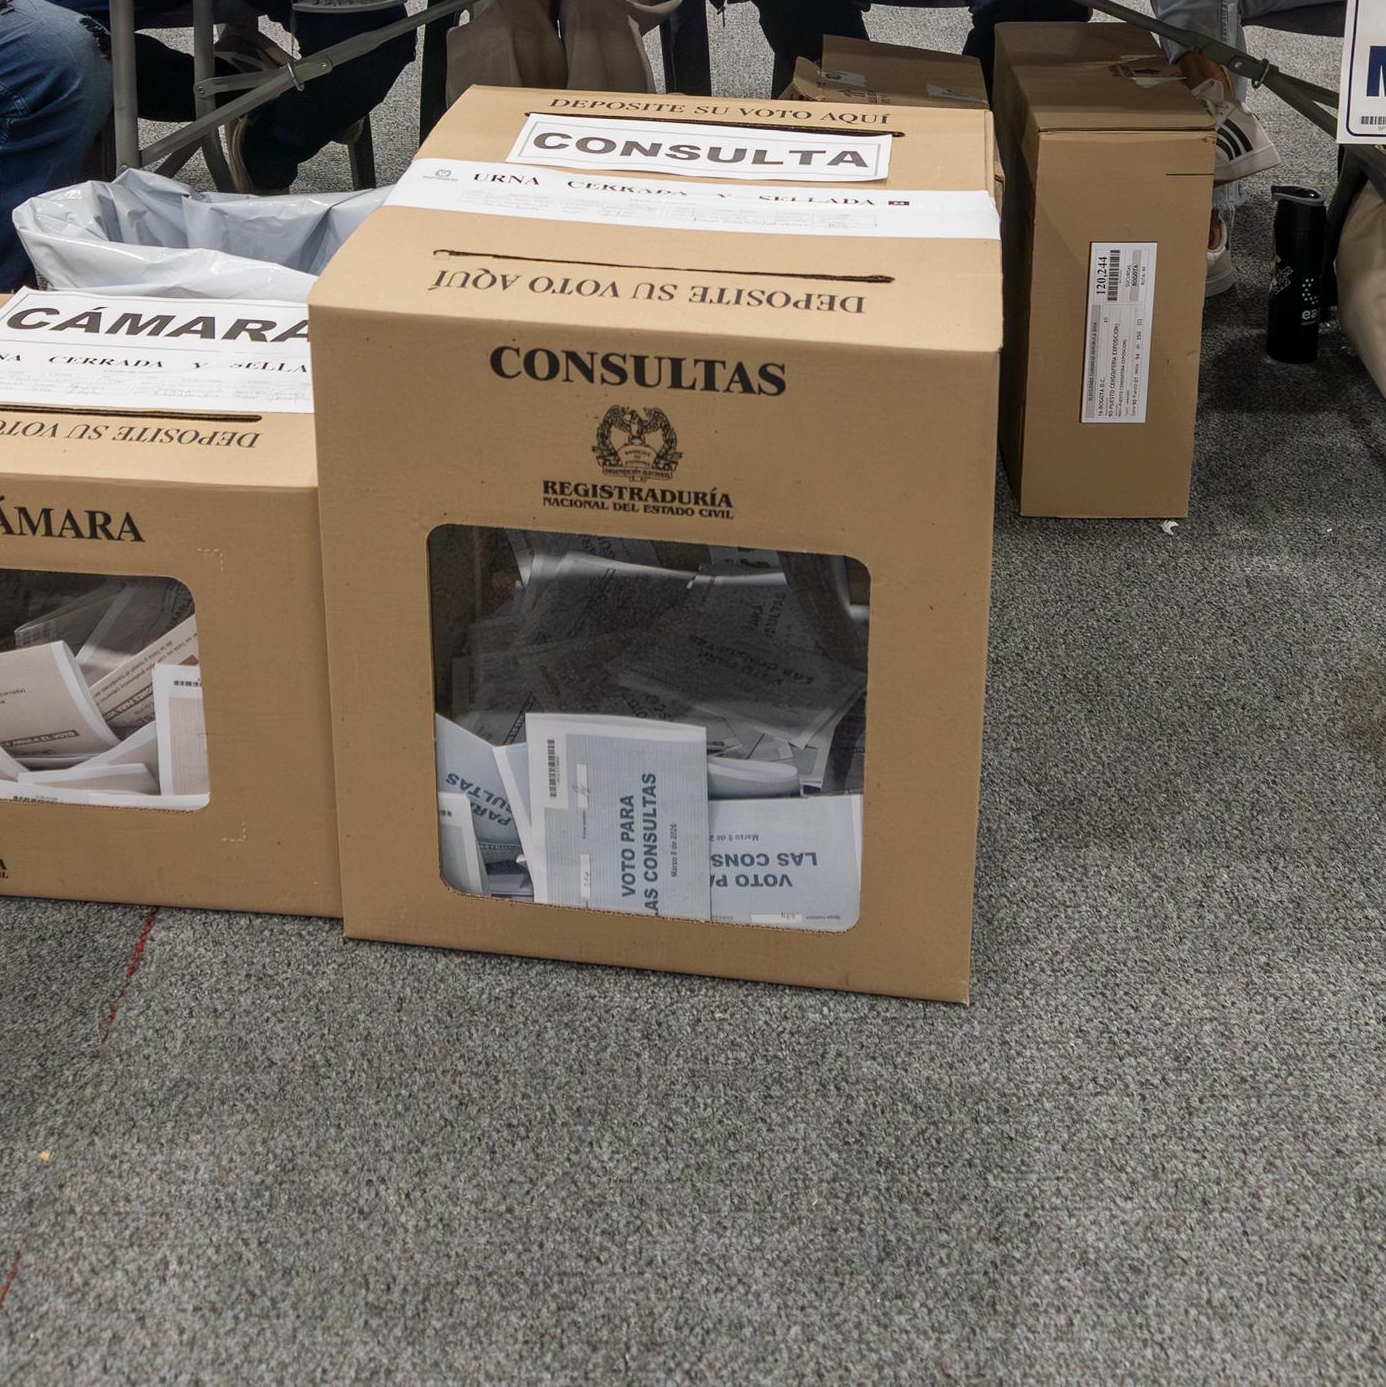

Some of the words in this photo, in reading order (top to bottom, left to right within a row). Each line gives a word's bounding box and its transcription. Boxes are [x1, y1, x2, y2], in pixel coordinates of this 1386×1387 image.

[549, 97, 685, 115] DEPOSITE
[692, 103, 730, 117] SU
[740, 106, 813, 120] VOTO
[821, 112, 892, 125] AQUÍ
[530, 131, 870, 169] CONSULTA
[472, 173, 540, 186] URNA
[428, 267, 520, 294] AQUÍ
[527, 275, 621, 298] VOTO
[1096, 256, 1108, 295] 120,244
[631, 281, 677, 303] SU
[689, 284, 868, 315] DEPOSITE
[6, 305, 310, 344] CÁMARA
[48, 355, 165, 369] CERRADA
[490, 346, 787, 397] CONSULTAS
[65, 422, 110, 441] SU
[111, 424, 265, 449] DEPOSITE
[542, 479, 734, 509] REGISTRADURÍA
[542, 496, 609, 511] NACIONAL
[613, 502, 639, 513] DEL
[643, 504, 695, 517] ESTADO
[699, 507, 735, 520] CIVIL
[621, 794, 635, 843] PARA
[641, 773, 658, 883] CONSULTAS
[621, 848, 636, 897] VOTO
[776, 852, 818, 867] LAS
[735, 873, 793, 888] VOTO
